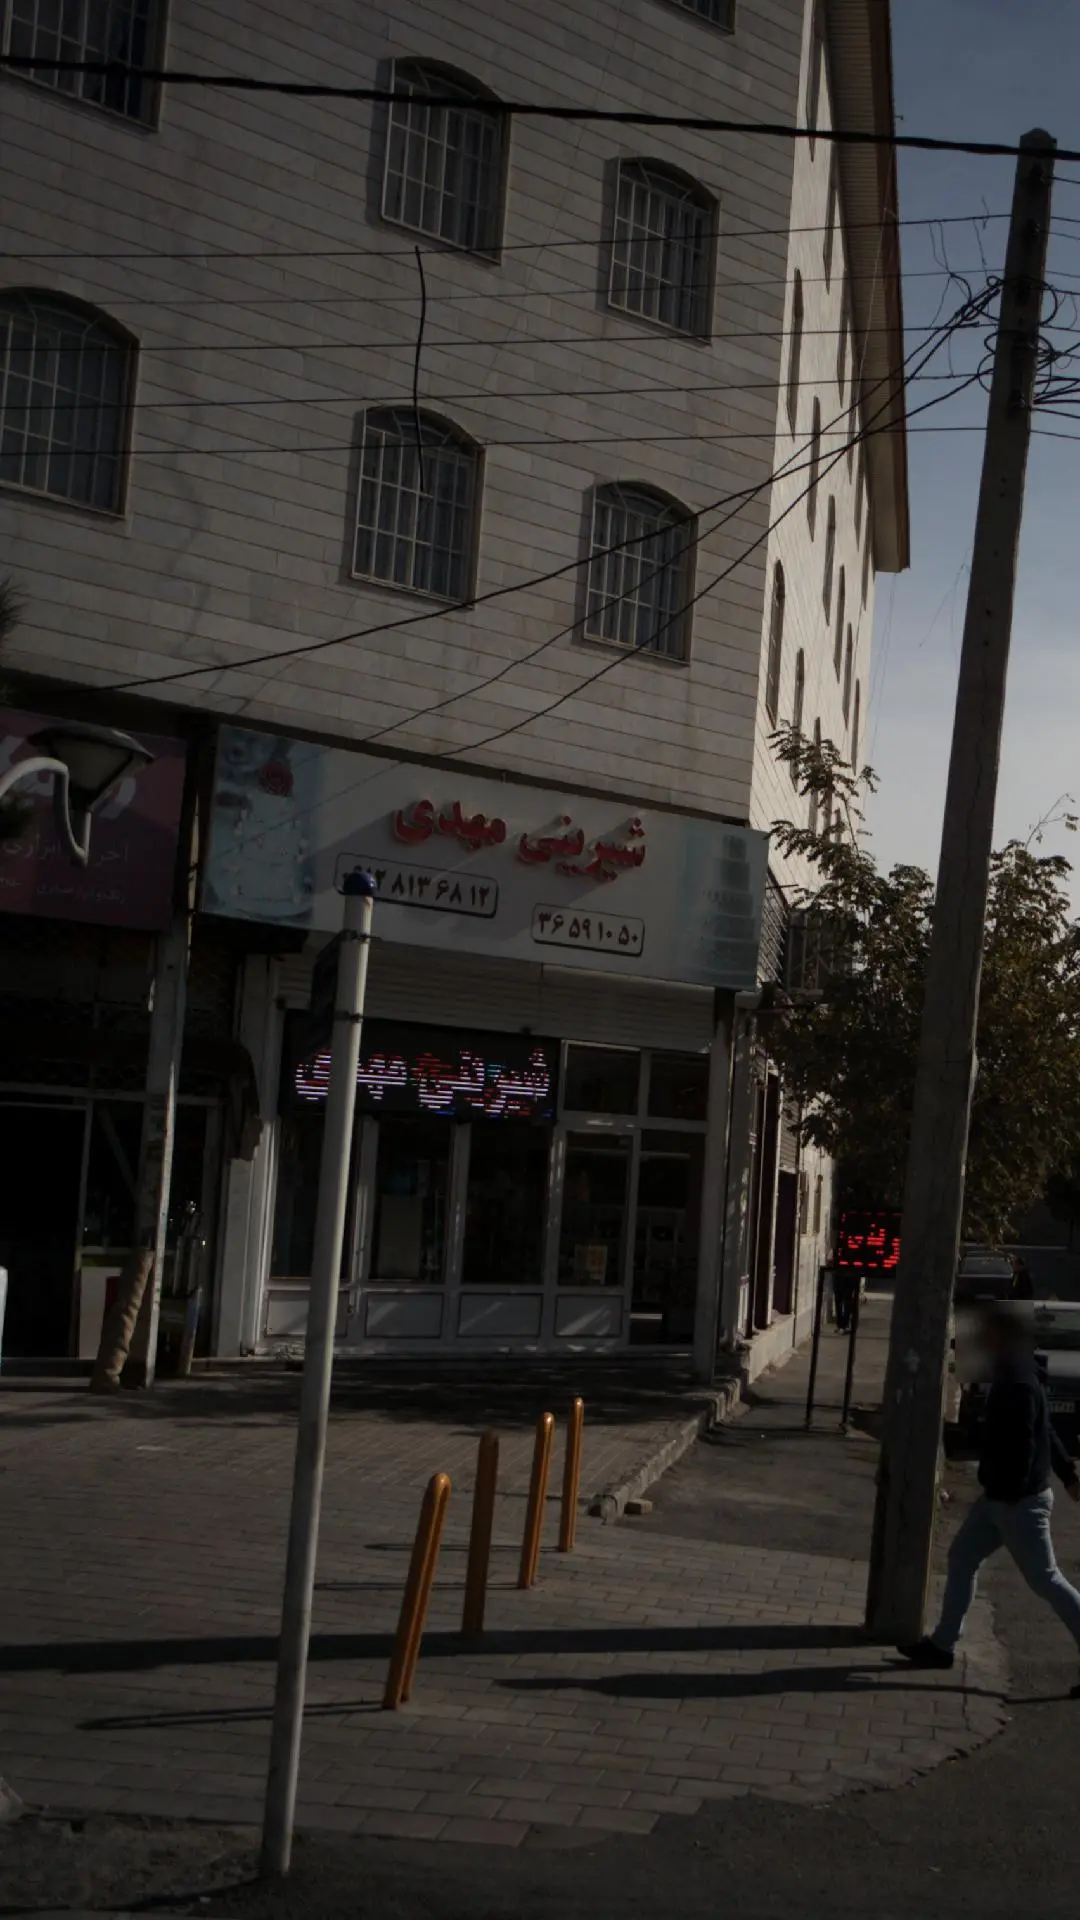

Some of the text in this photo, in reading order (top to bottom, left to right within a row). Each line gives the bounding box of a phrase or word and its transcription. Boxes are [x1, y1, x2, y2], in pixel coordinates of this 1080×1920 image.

[393, 799, 646, 881] شیرینی مهدی
[294, 1046, 408, 1101] مهی
